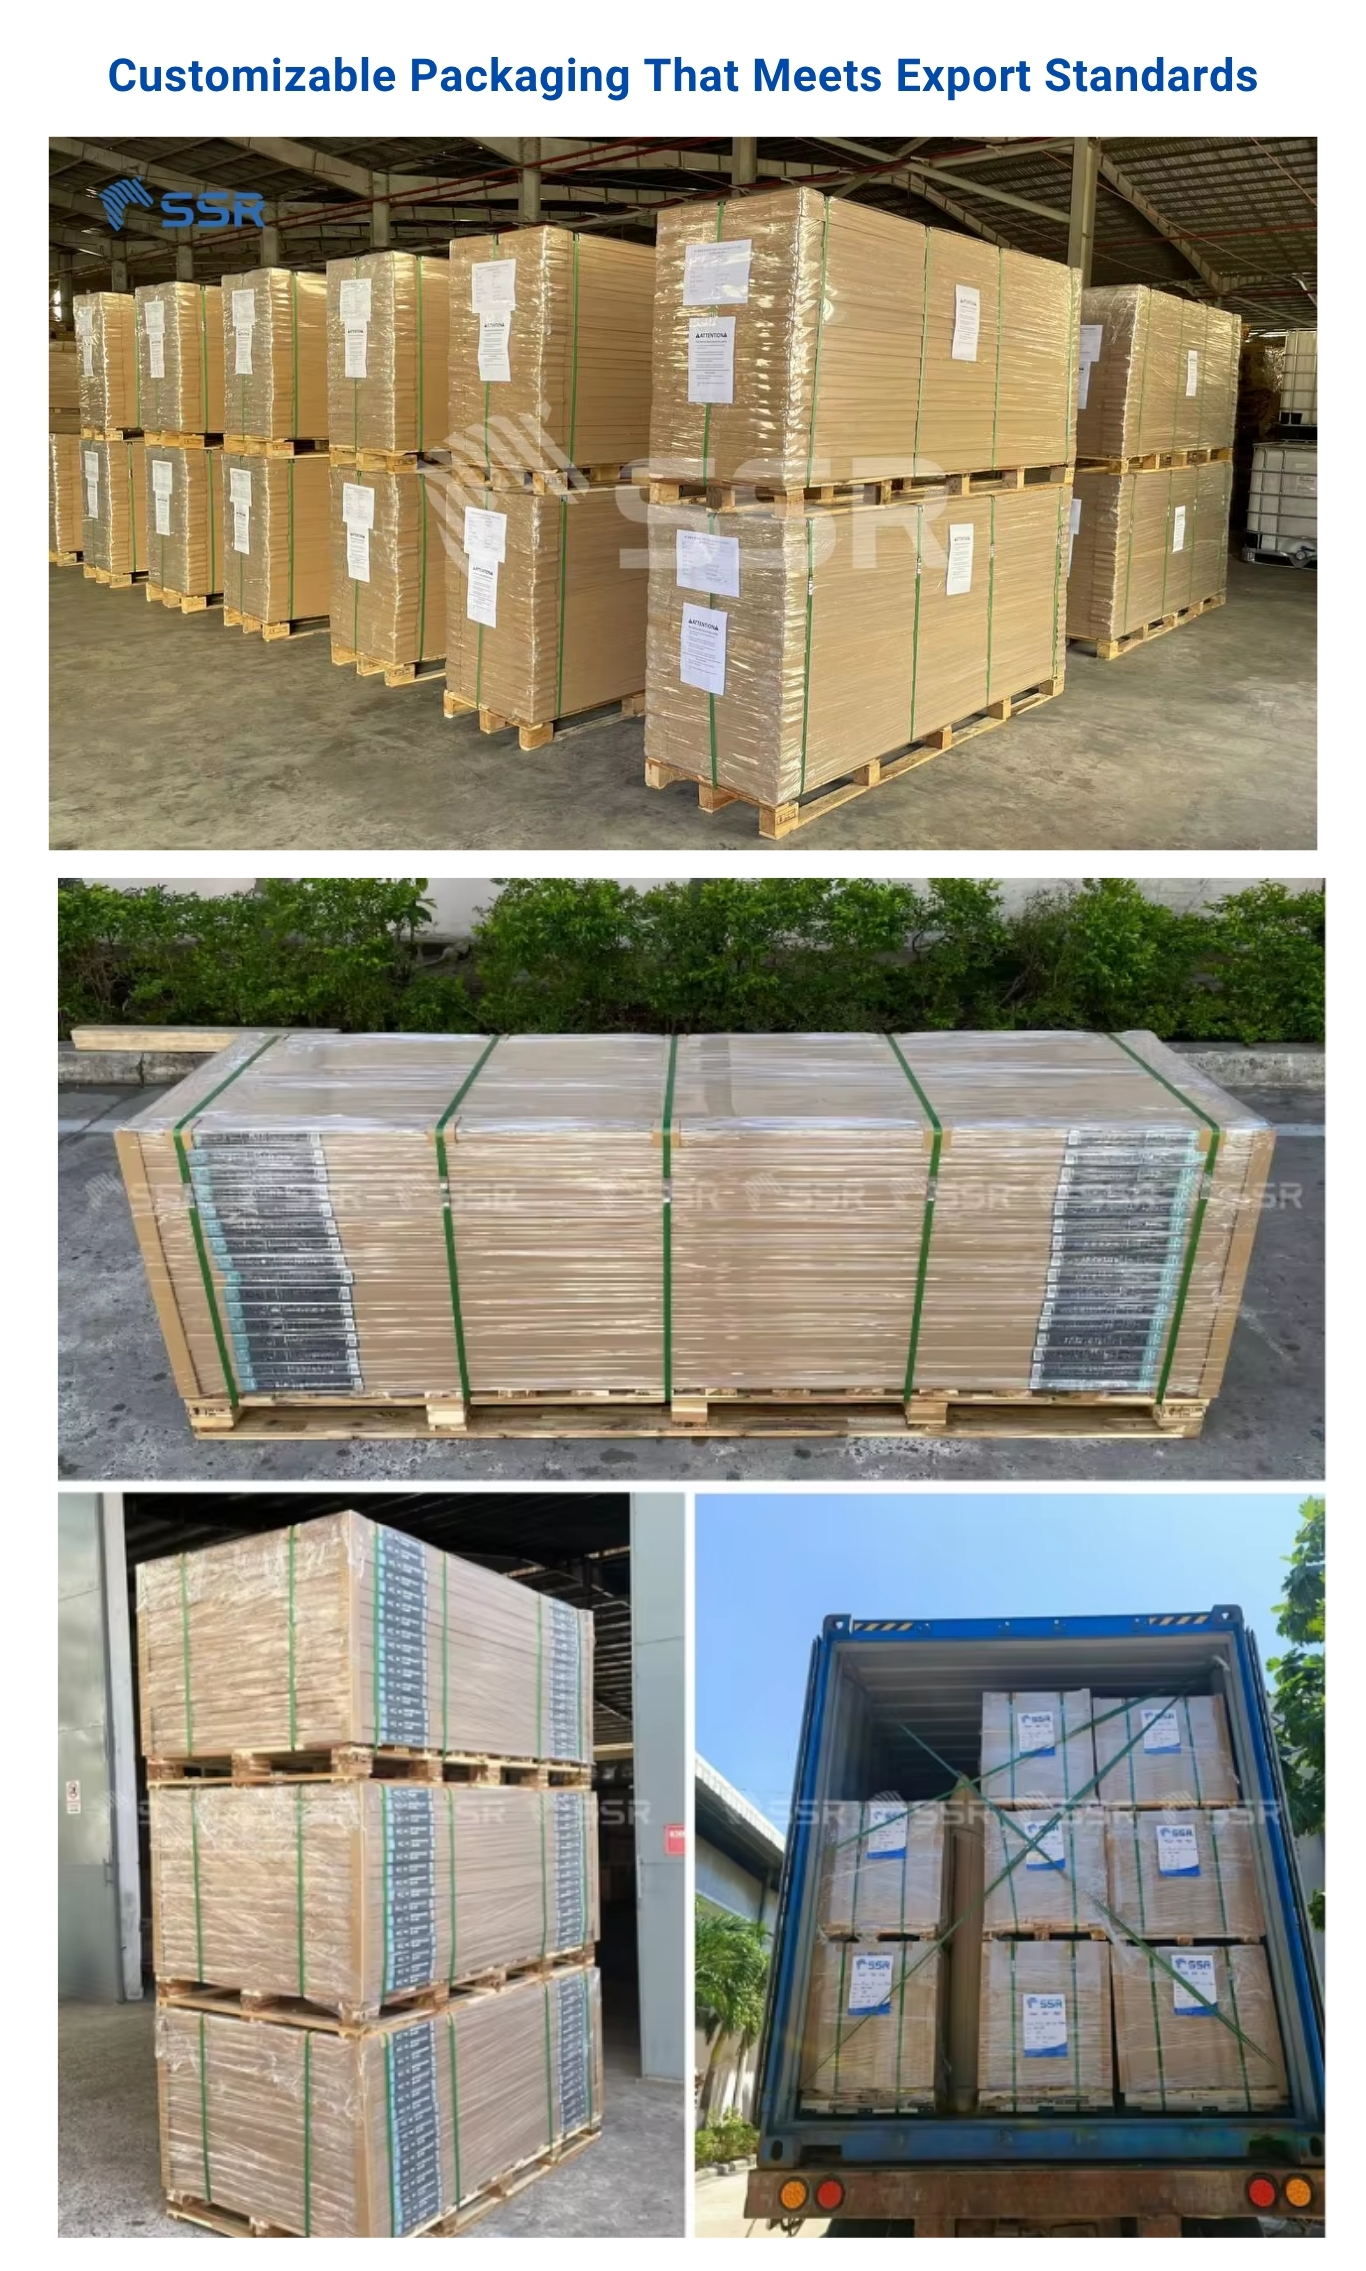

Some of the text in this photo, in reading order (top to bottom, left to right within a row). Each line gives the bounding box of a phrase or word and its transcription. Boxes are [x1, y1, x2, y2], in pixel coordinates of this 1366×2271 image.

[868, 1961, 891, 1970] SSR
[1188, 1960, 1212, 1970] SSR
[1040, 1999, 1063, 2009] SSR
